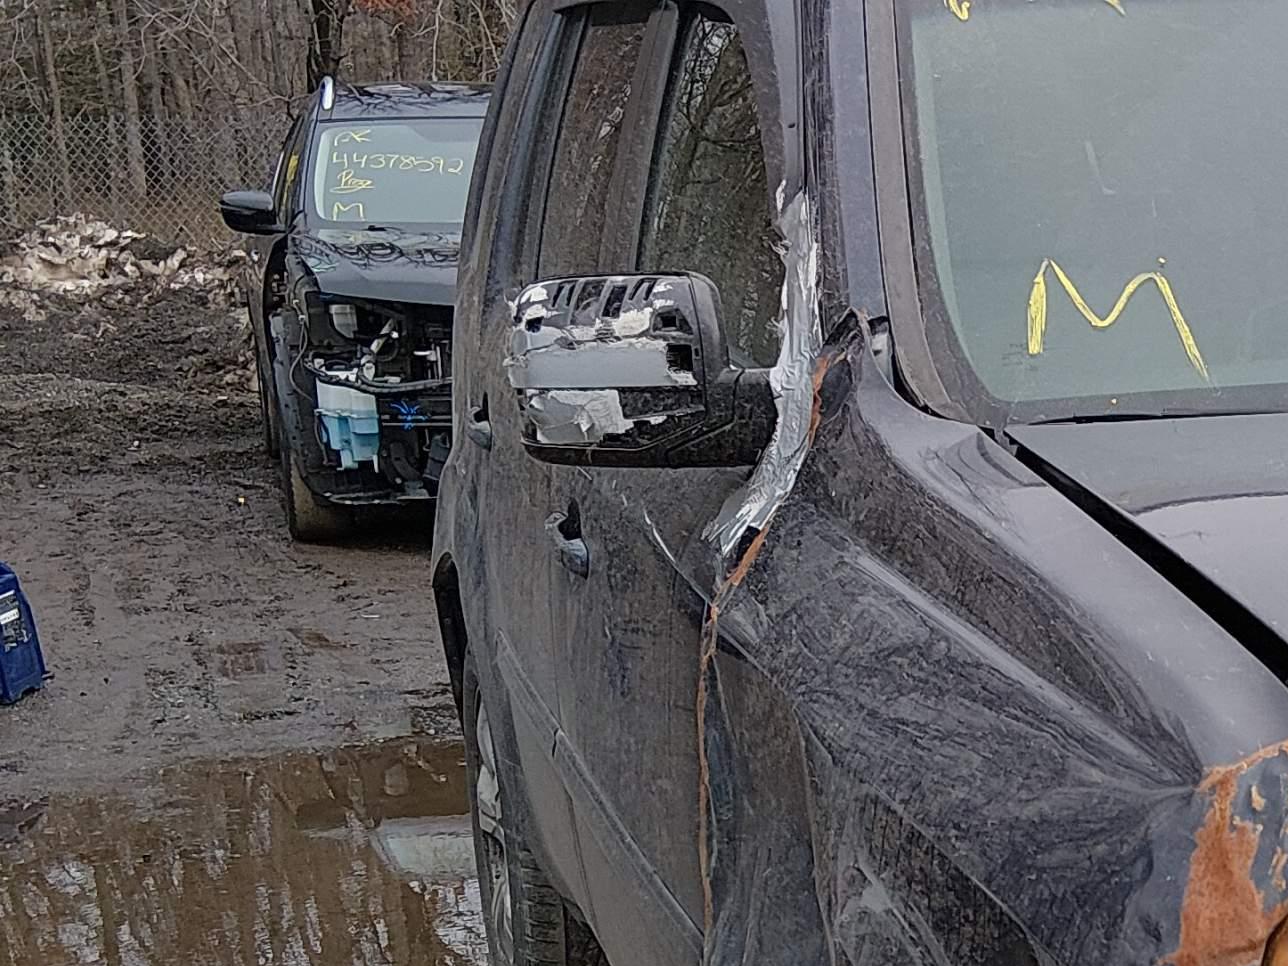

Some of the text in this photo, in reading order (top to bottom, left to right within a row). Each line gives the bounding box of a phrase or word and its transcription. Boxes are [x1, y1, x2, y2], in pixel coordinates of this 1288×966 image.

[332, 151, 464, 175] 44378592
[333, 202, 366, 221] M
[1027, 257, 1210, 382] M
